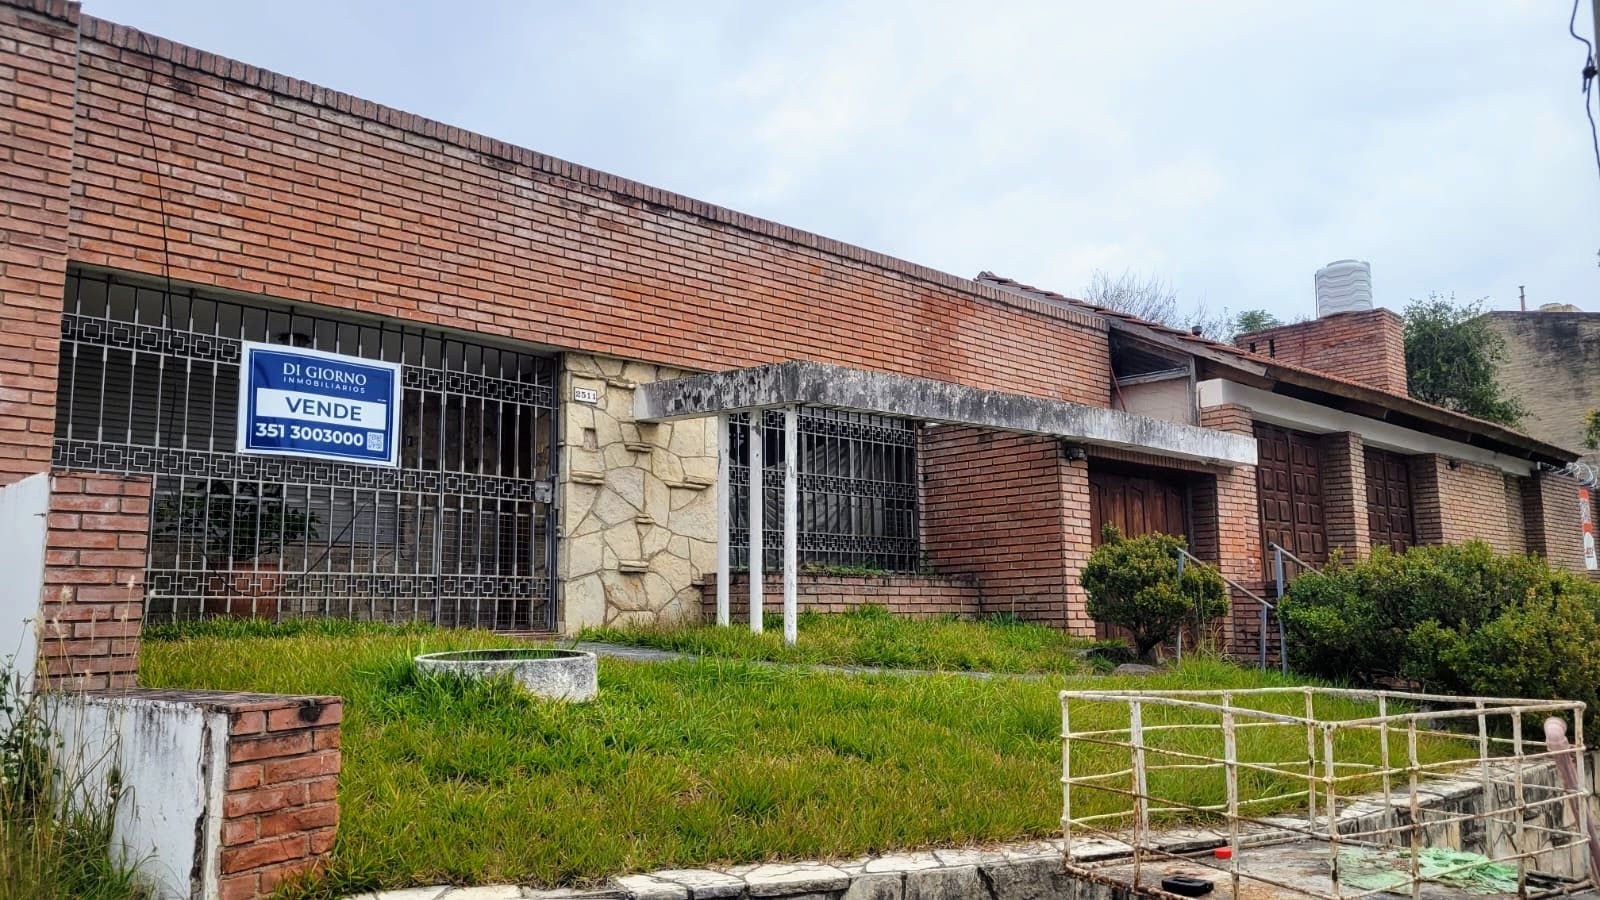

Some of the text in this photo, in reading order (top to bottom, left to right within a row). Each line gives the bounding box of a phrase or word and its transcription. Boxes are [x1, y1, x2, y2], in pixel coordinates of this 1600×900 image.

[283, 362, 367, 386] DI GIORNO
[283, 377, 366, 394] INMOBILIARIOS
[575, 390, 596, 400] 2511
[285, 396, 362, 422] VENDE
[255, 423, 364, 447] 351 3003000
